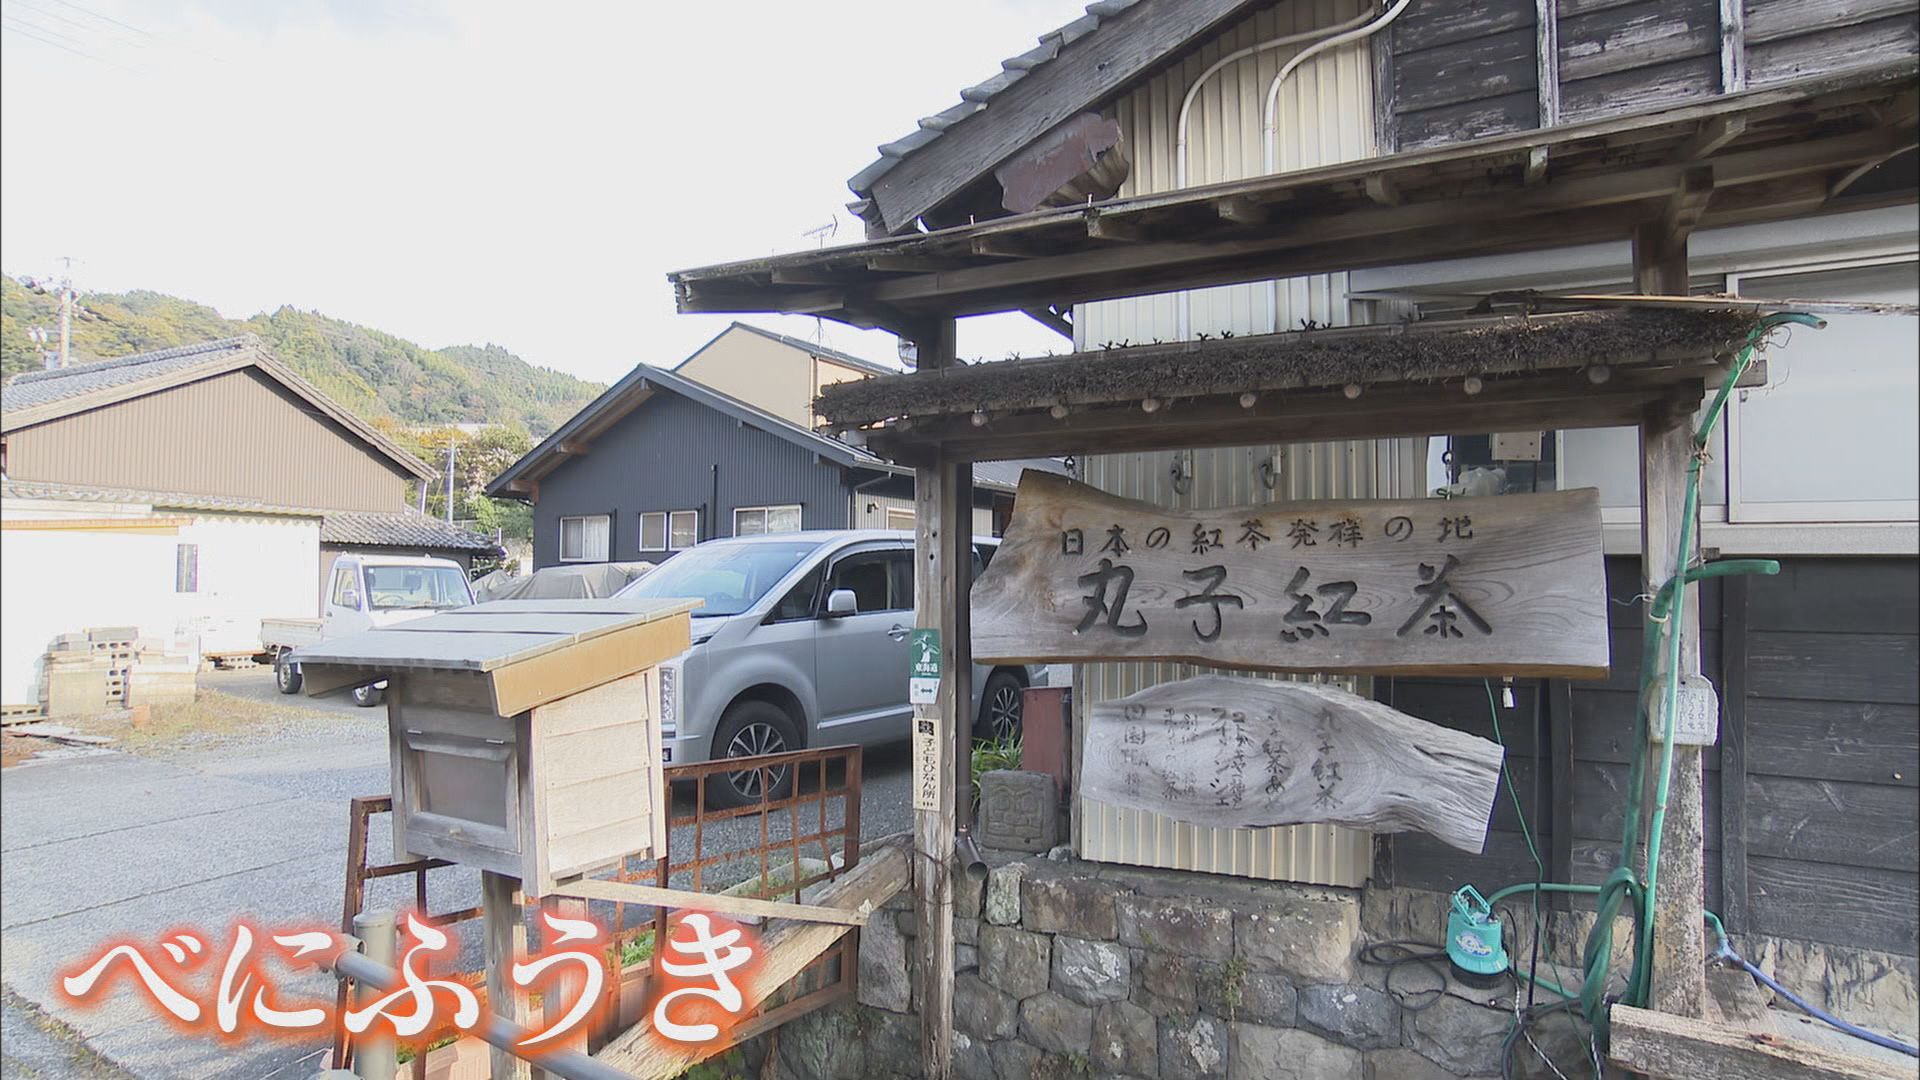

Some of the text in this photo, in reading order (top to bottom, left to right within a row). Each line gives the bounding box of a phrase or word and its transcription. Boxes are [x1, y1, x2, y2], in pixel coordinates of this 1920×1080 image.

[1060, 514, 1476, 557] 日本の紅茶発祥の地
[1072, 554, 1494, 643] 丸子紅茶
[922, 737, 936, 799] 子どもひなん所
